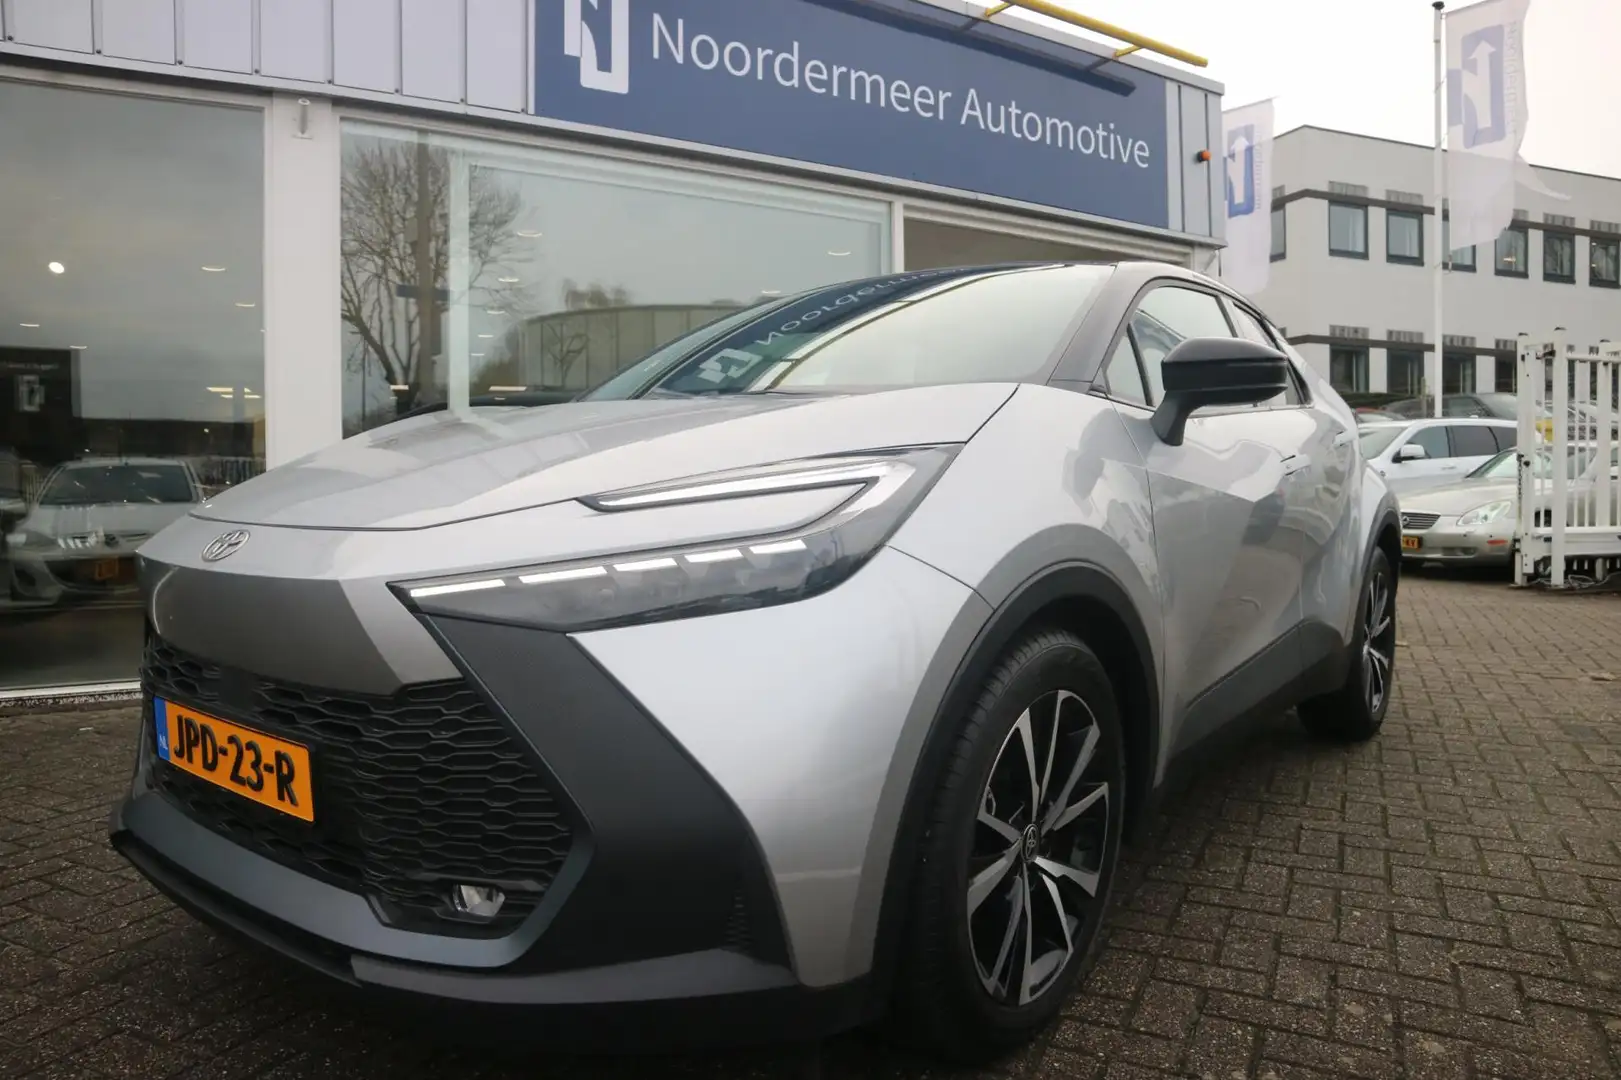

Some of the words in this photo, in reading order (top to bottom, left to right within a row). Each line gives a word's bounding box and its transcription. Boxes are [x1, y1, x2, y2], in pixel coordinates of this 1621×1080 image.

[652, 12, 953, 121] Noordermeer
[960, 87, 1151, 168] Automotive
[173, 714, 299, 807] JPD-23-R
